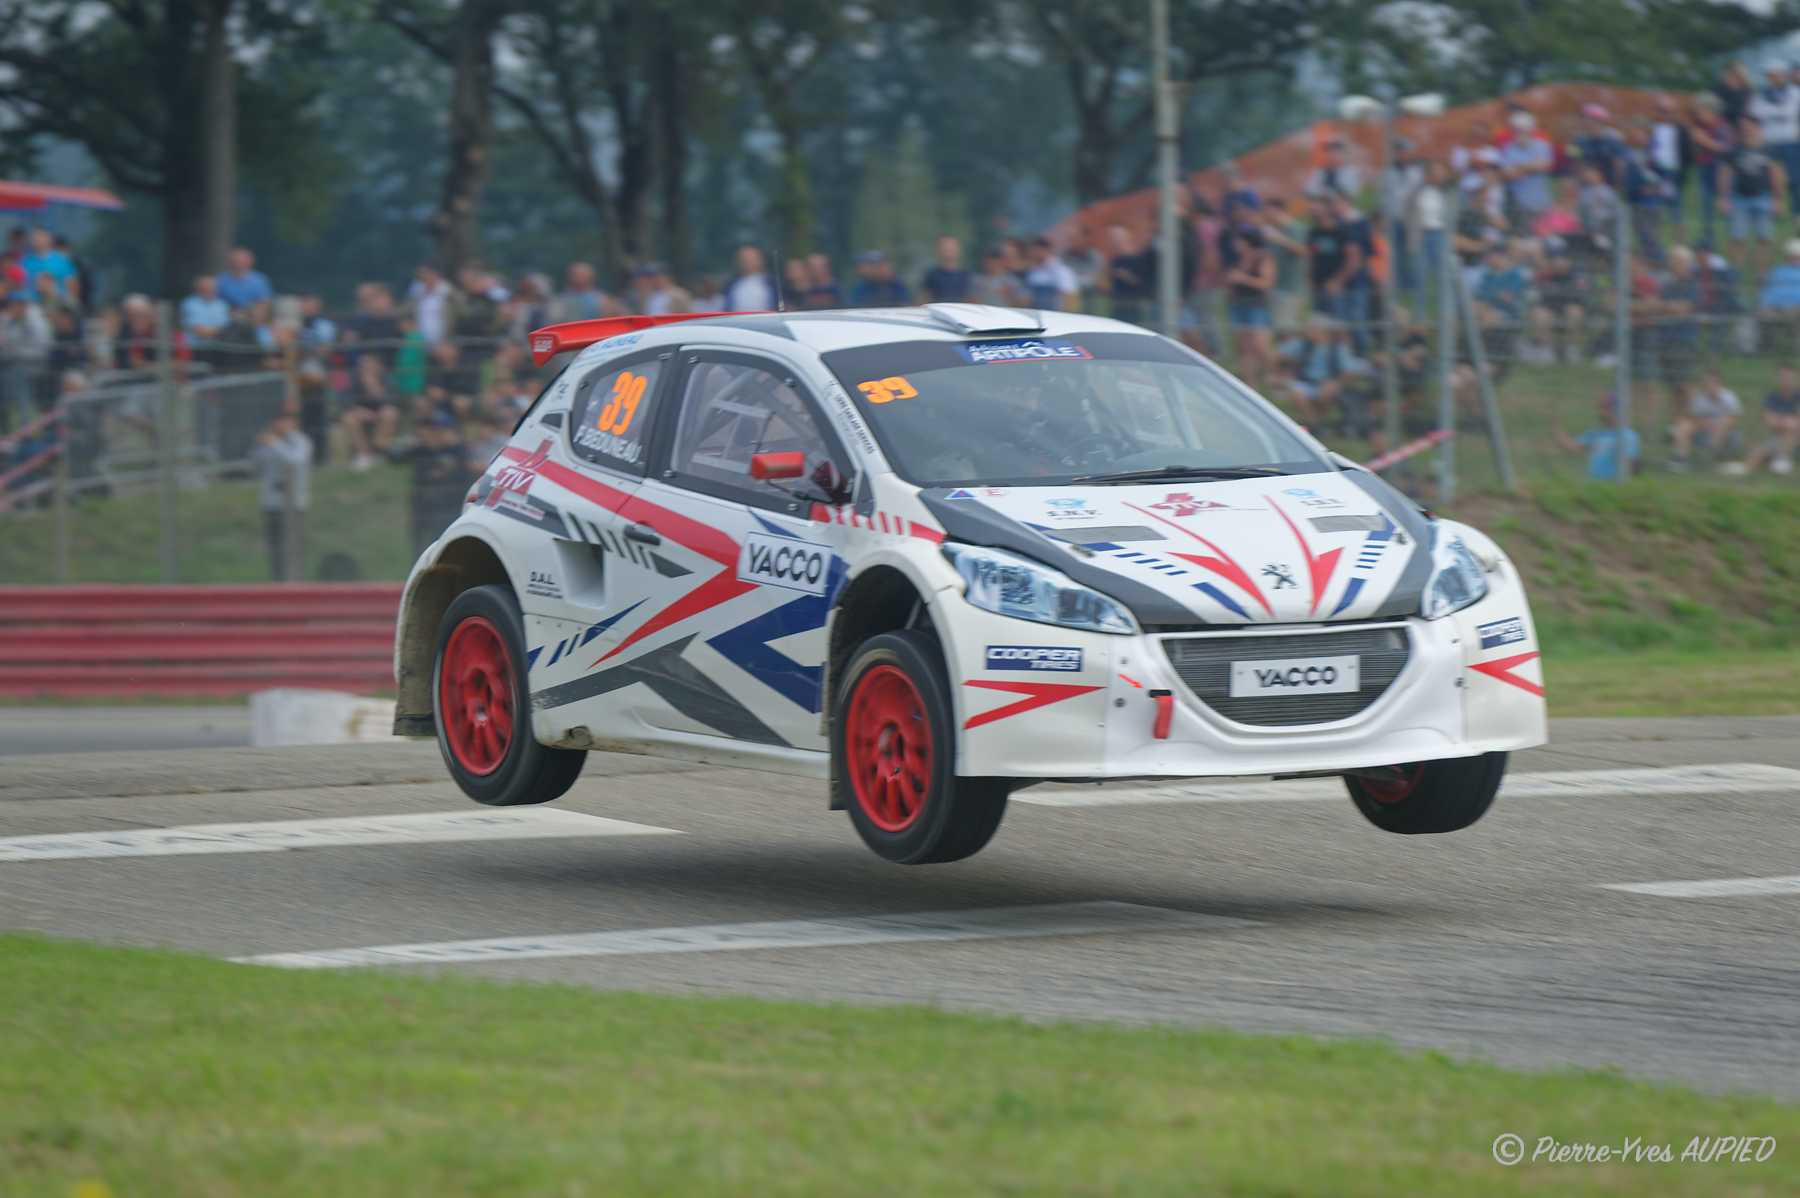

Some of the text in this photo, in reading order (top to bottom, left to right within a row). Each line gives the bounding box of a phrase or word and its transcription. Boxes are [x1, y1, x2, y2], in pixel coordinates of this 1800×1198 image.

[596, 371, 648, 436] 39
[857, 376, 918, 405] 39
[748, 543, 822, 584] YACCO
[987, 648, 1081, 661] COOPER
[1252, 666, 1337, 688] YACCO
